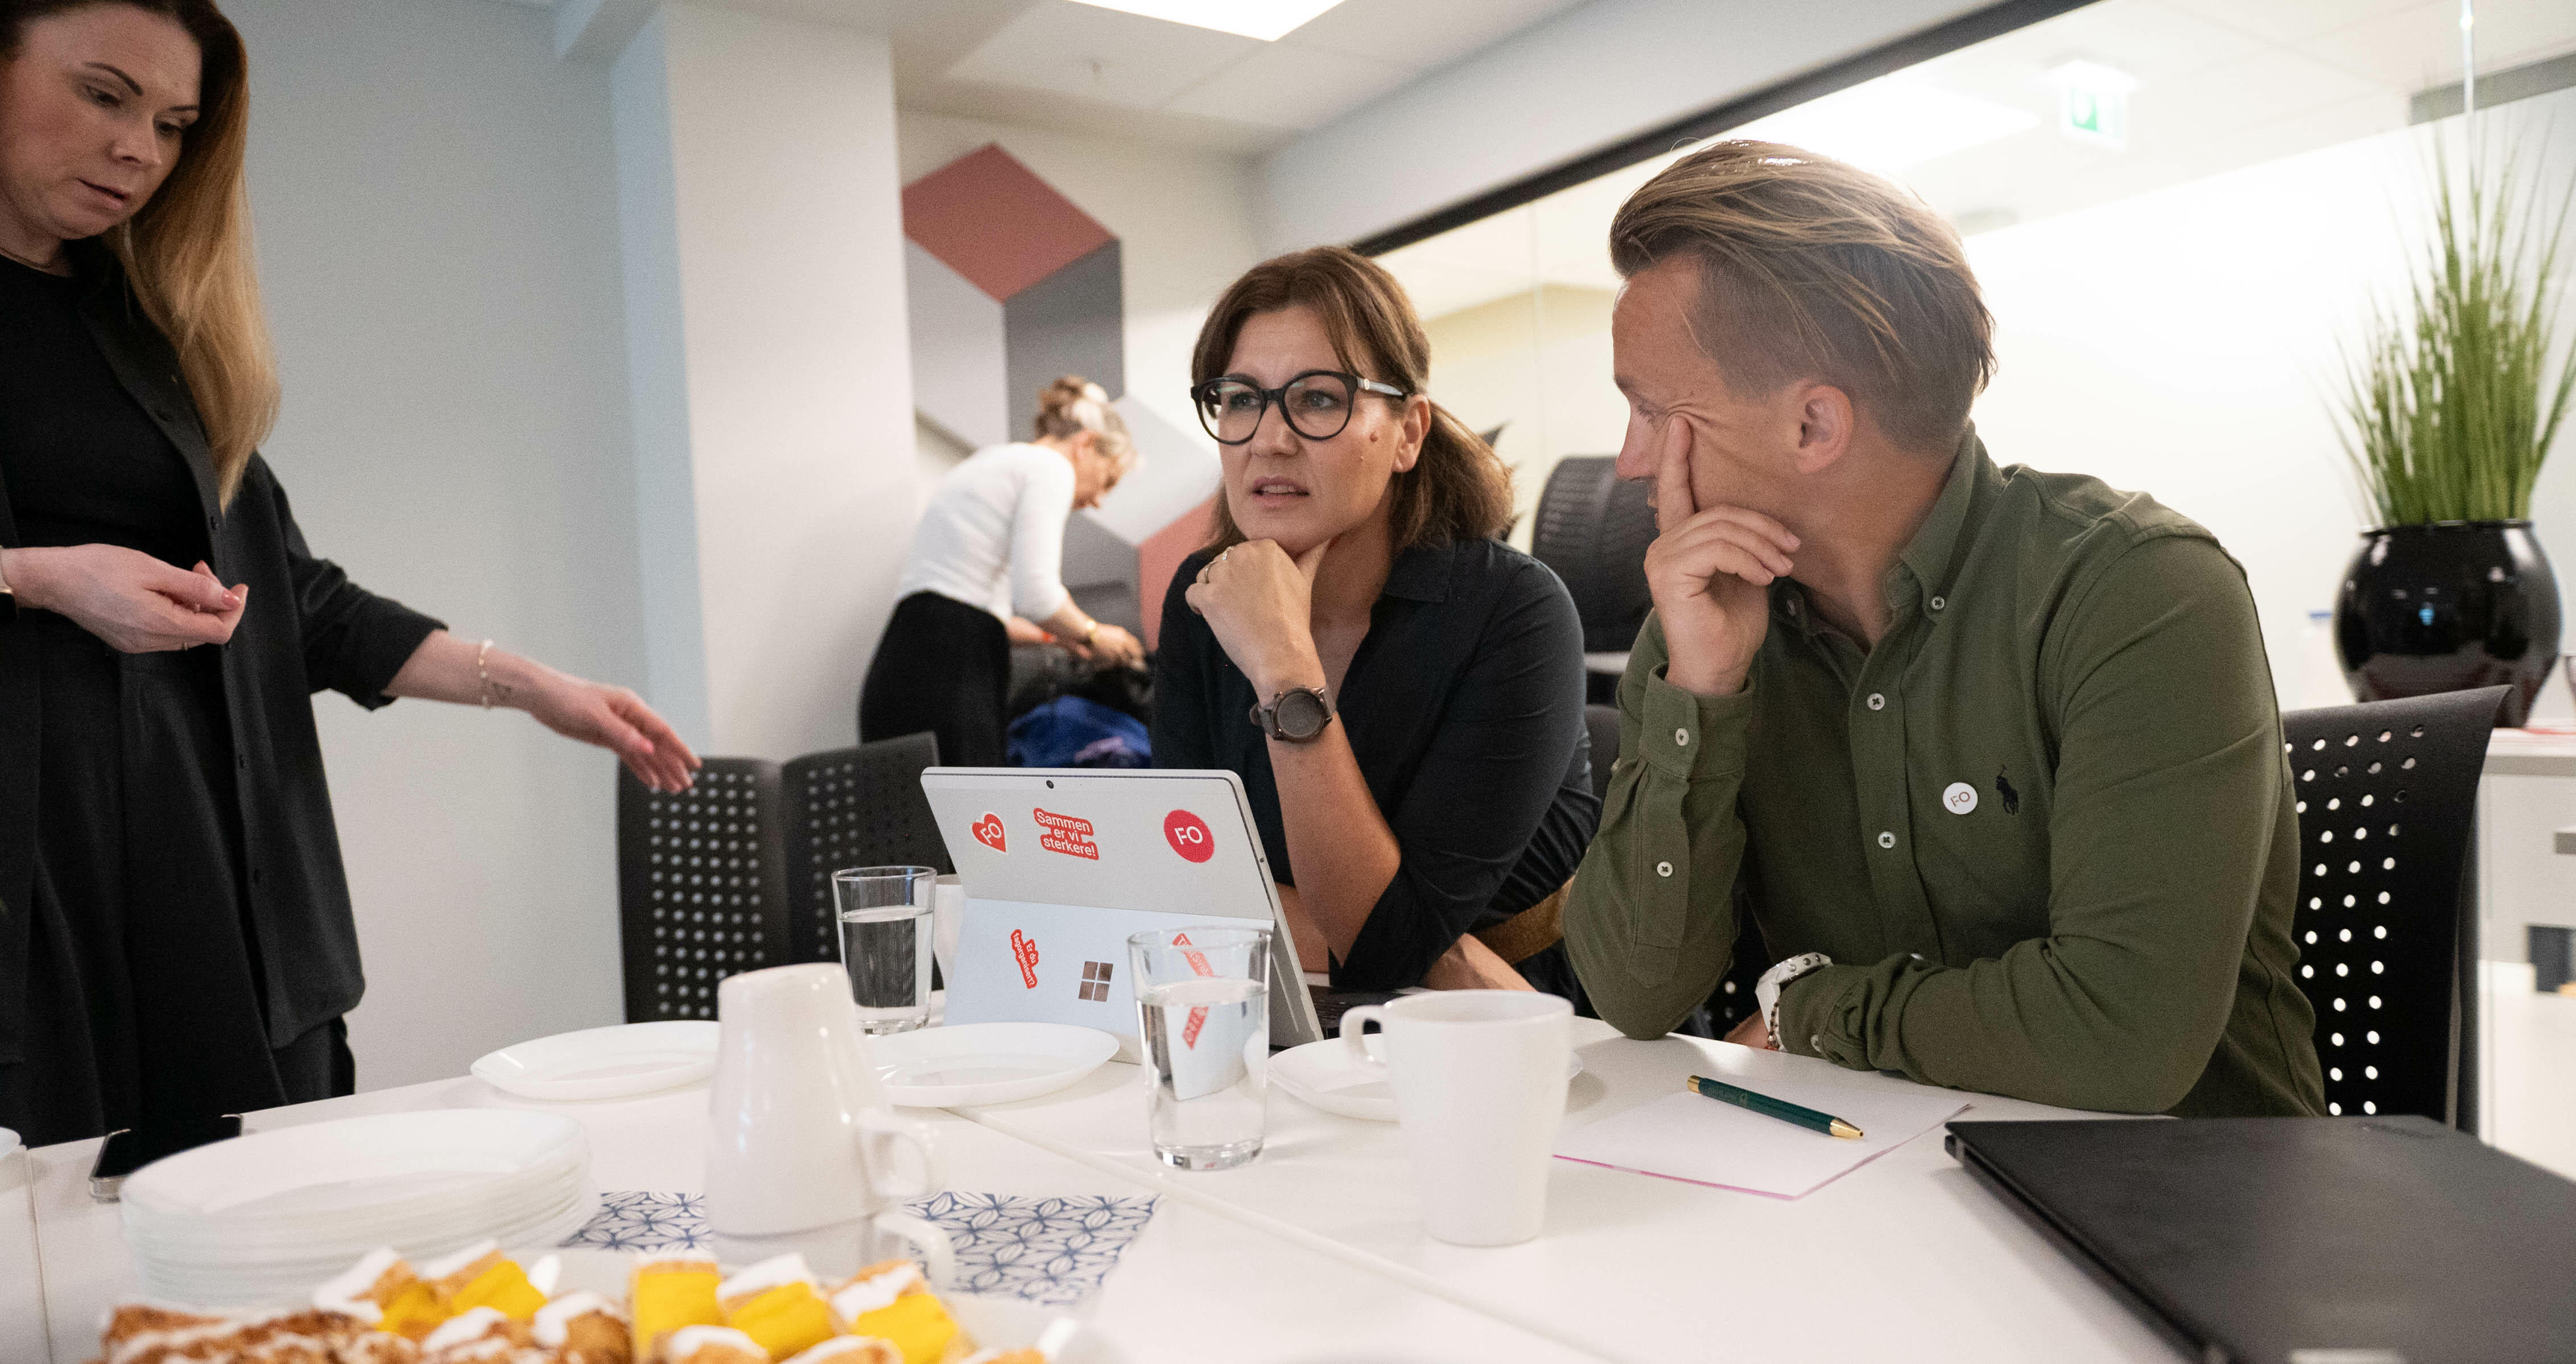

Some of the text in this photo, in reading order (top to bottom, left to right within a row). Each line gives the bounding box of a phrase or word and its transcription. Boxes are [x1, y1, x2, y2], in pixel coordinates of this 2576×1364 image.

[1950, 792, 1970, 806] FO
[1037, 811, 1091, 833] Sammen
[980, 823, 1002, 844] FO
[1054, 828, 1079, 842] er vi
[1174, 826, 1203, 845] FO
[1043, 837, 1096, 857] sterkere!
[1013, 932, 1035, 986] fagorganisert?
[1026, 943, 1037, 964] Er du
